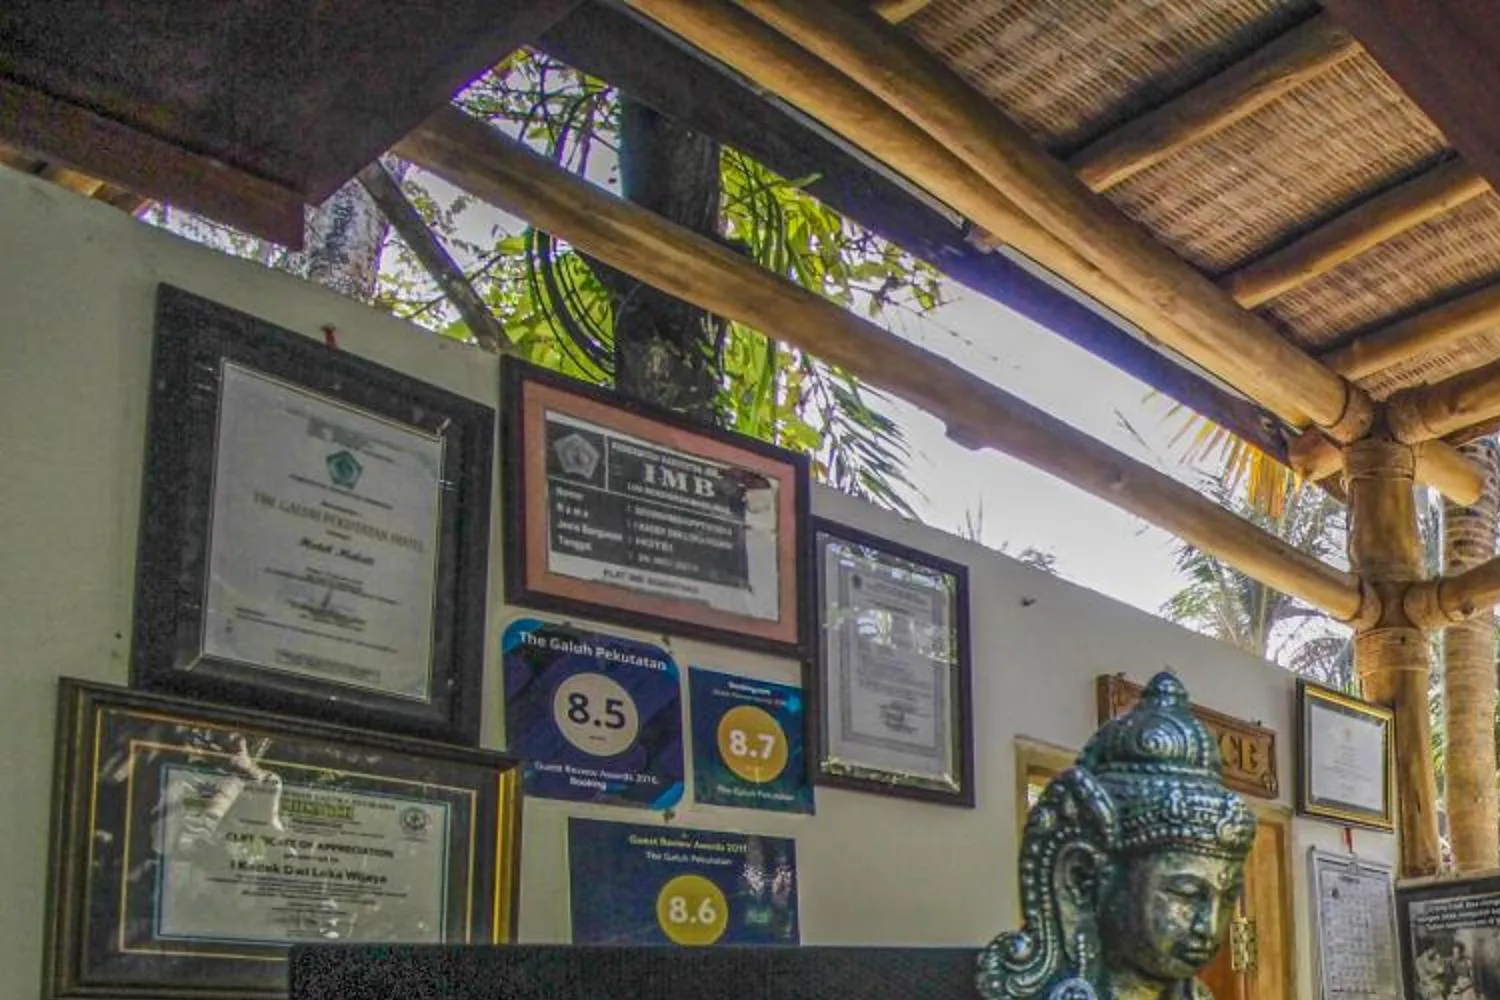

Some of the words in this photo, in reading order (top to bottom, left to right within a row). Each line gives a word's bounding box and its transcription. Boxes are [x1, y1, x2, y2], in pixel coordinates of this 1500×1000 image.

[642, 462, 716, 498] IMB
[520, 631, 547, 647] The
[550, 638, 593, 656] Galuh
[595, 646, 668, 671] Pekutatan
[567, 692, 626, 730] 8.5
[729, 728, 776, 760] 8.7
[668, 895, 718, 925] 8.6
